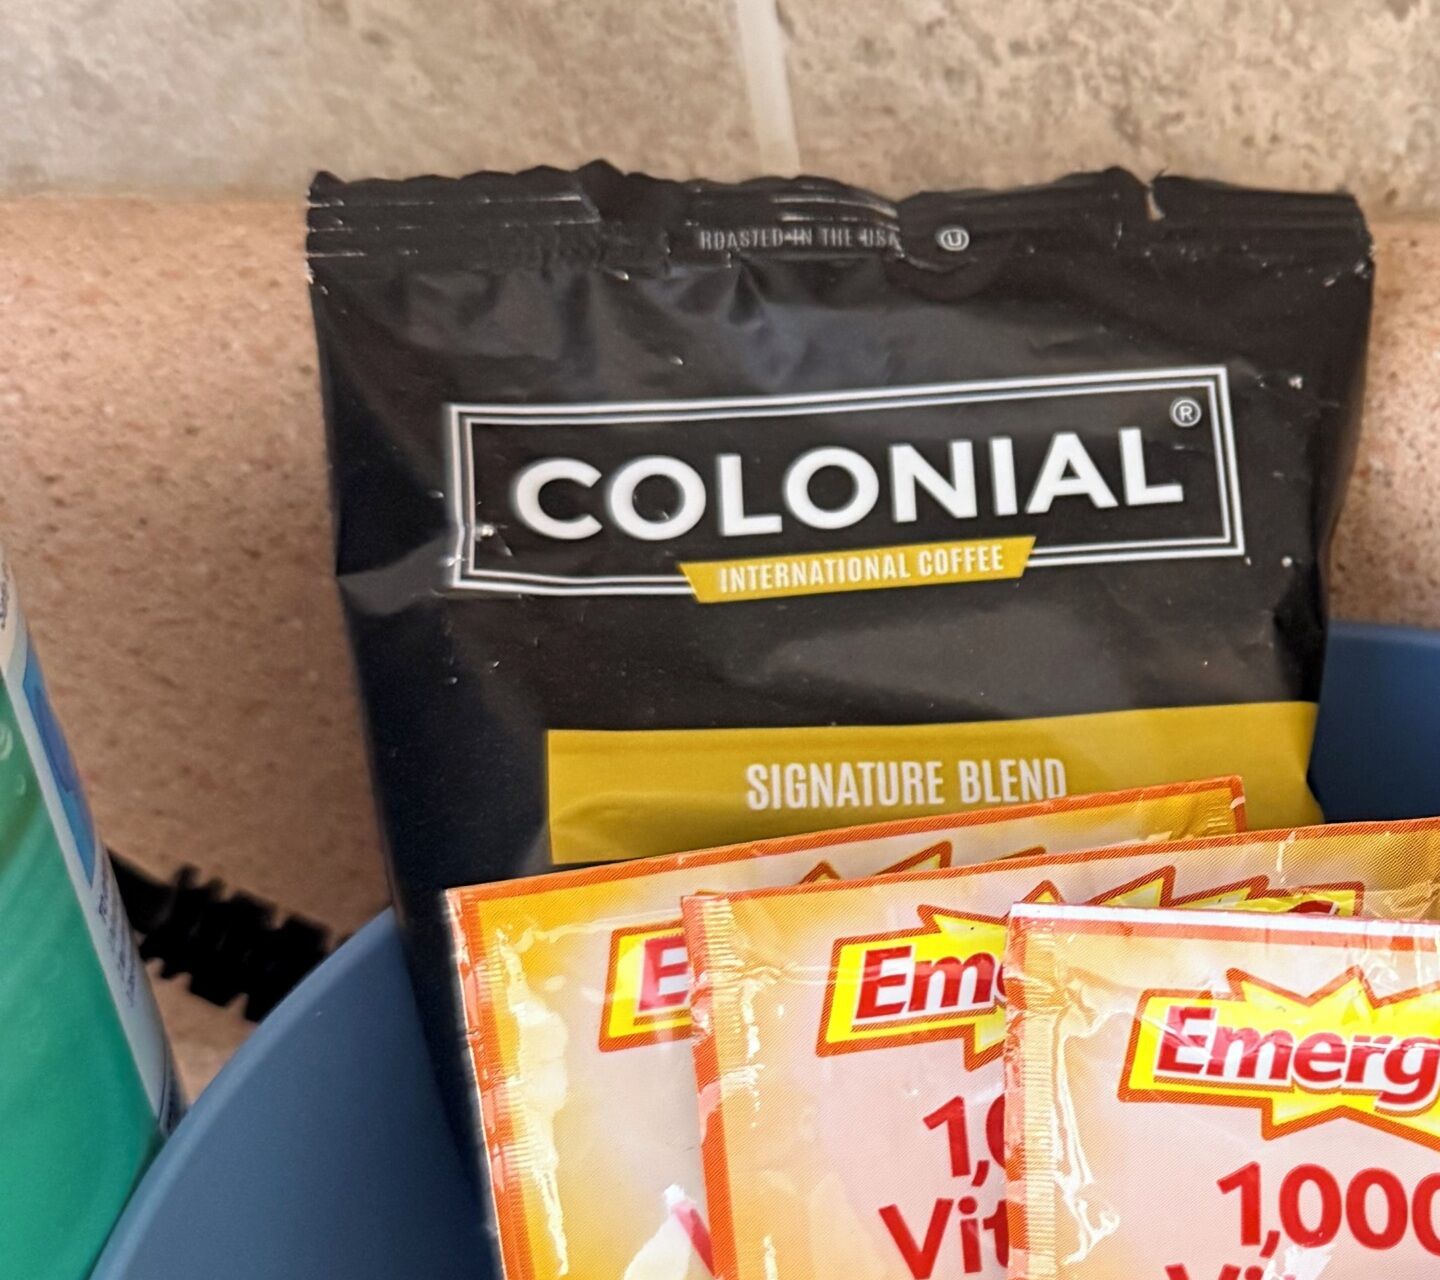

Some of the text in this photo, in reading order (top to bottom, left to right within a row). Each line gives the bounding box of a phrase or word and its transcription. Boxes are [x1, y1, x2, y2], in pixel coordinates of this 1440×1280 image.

[699, 226, 899, 251] ROASTED IN THE USA
[514, 427, 1184, 542] COLONIAL
[718, 544, 1006, 593] INTERNATIONAL COFFEE
[746, 757, 1068, 810] SIGNATURE BLEND
